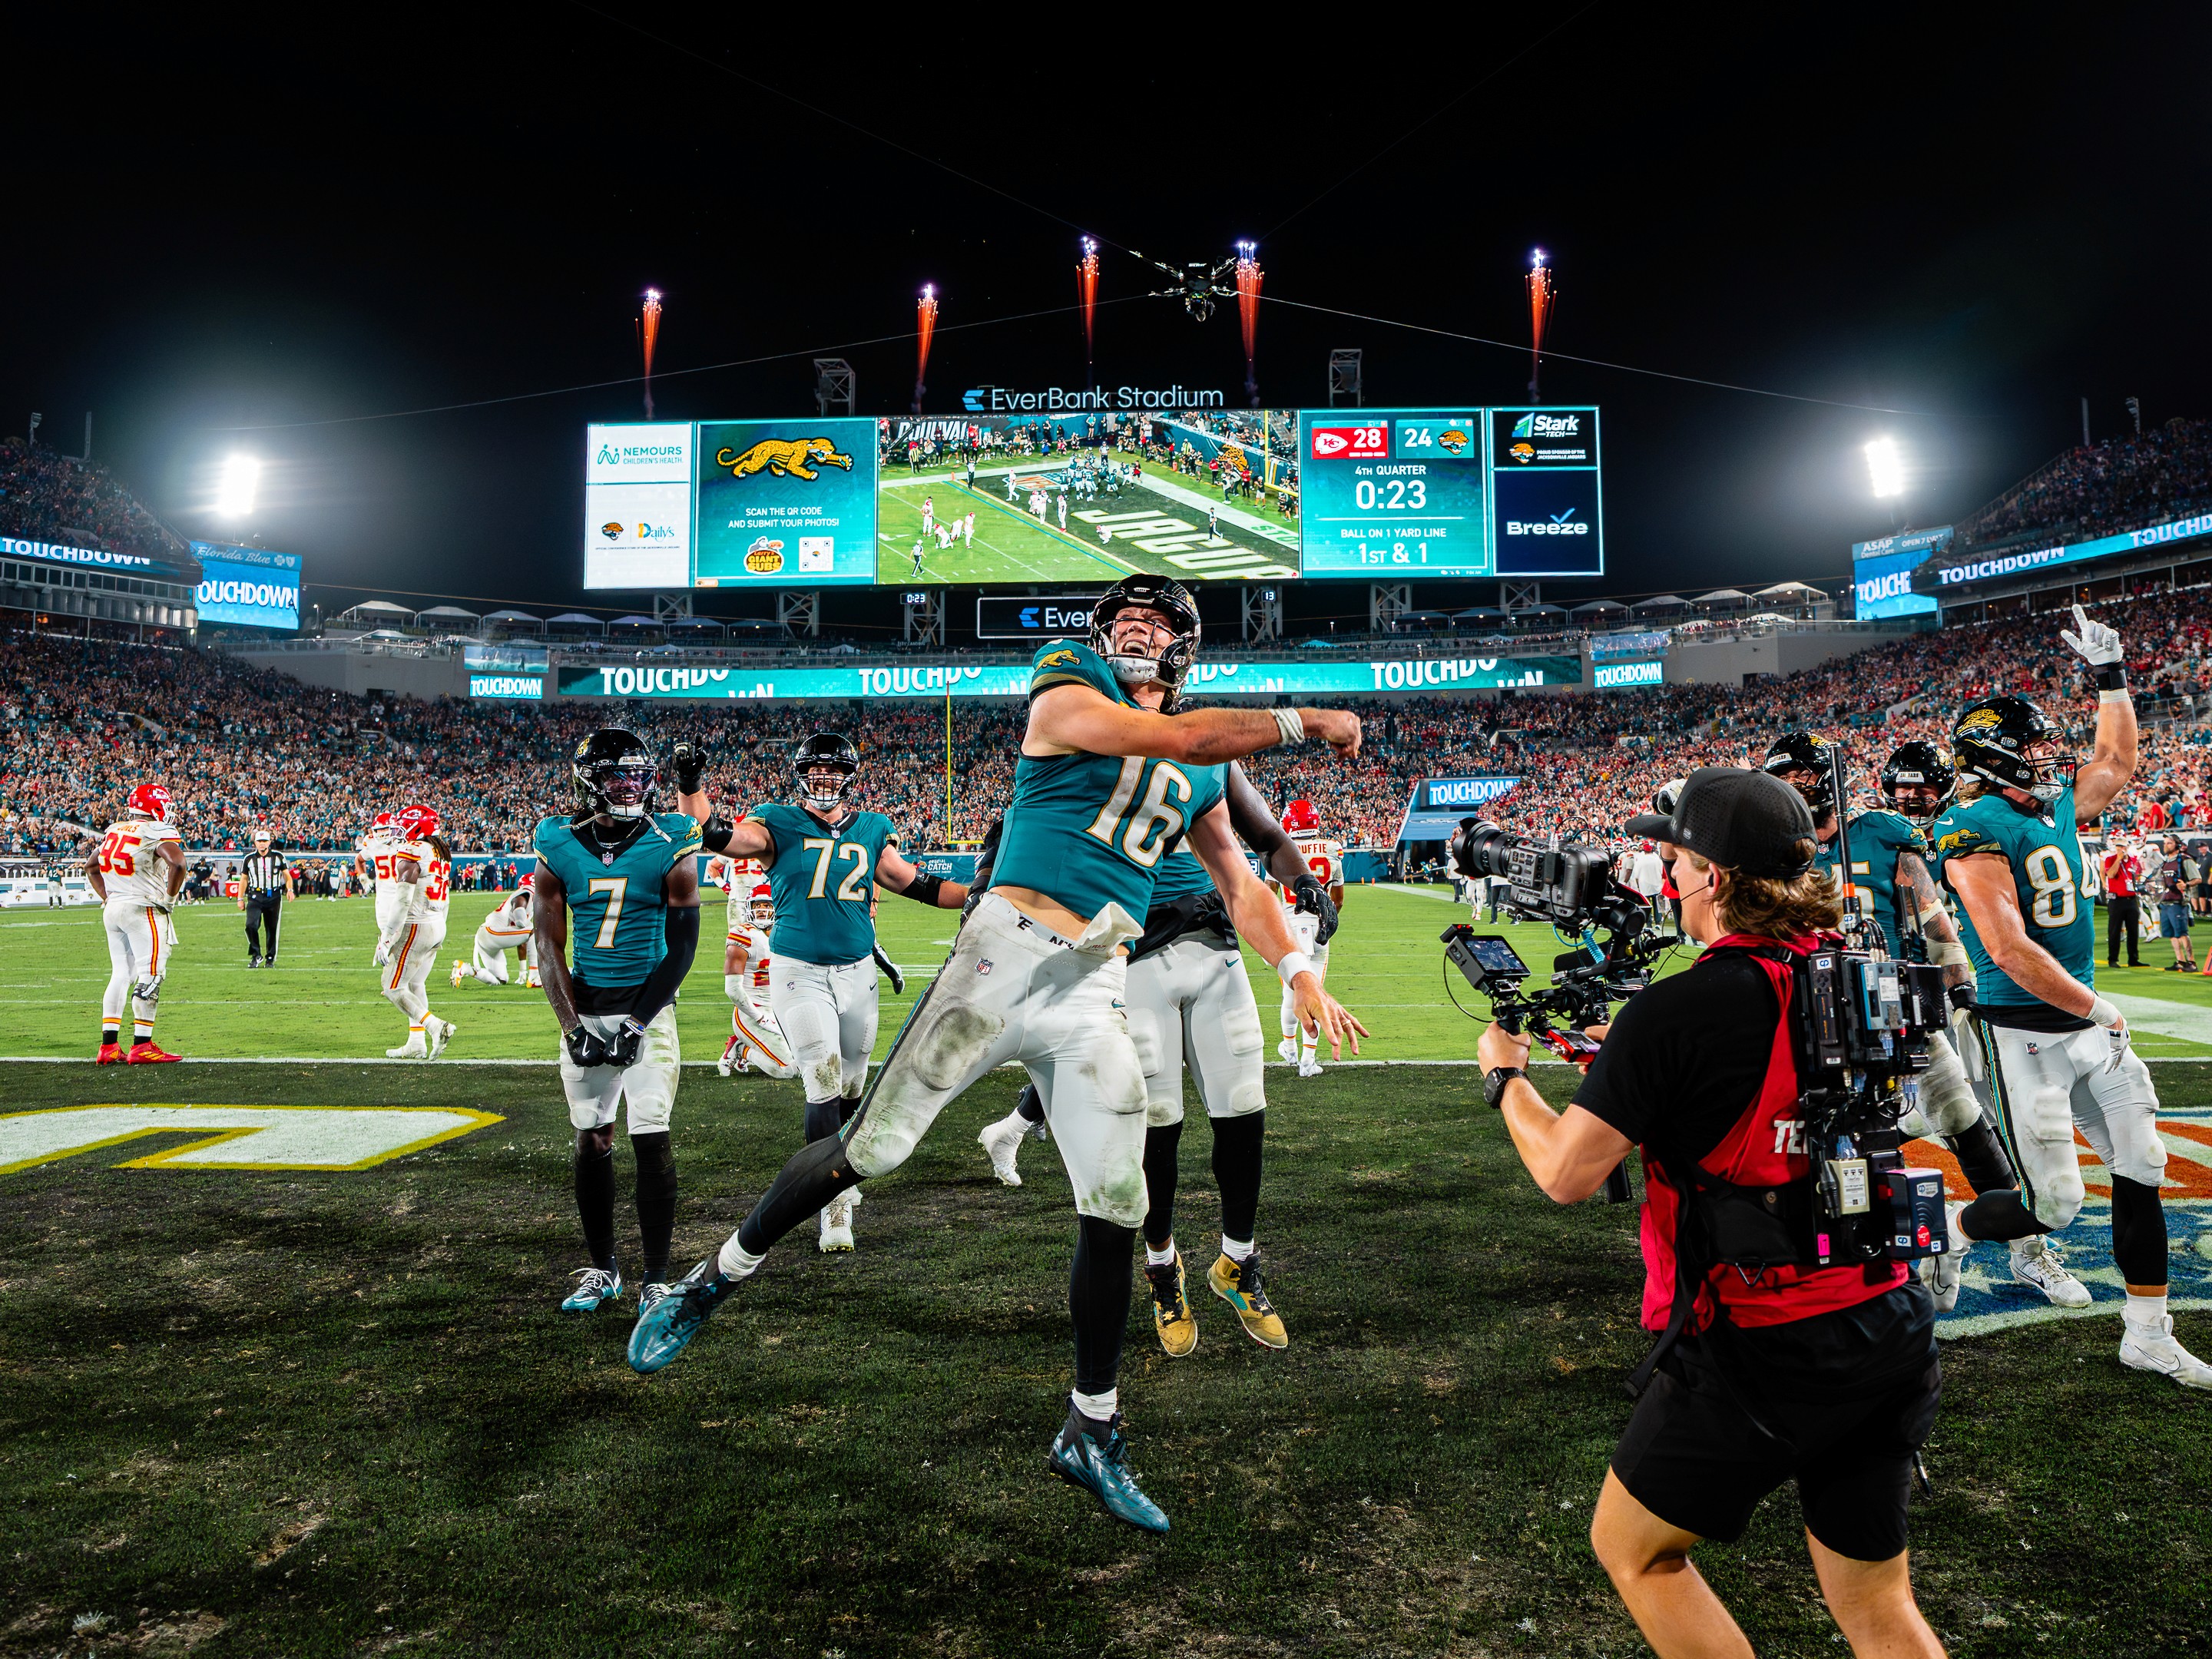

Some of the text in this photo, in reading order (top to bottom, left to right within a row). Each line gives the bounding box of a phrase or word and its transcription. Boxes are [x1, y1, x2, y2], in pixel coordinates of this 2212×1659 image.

[992, 385, 1224, 410] EverBank Stadium
[1534, 415, 1580, 431] Stark
[1353, 428, 1382, 448] 28
[1404, 428, 1432, 448] 24
[624, 446, 682, 456] NEMOURS
[1355, 465, 1427, 475] 4TH QUARTER
[1356, 479, 1427, 509] 0:23
[745, 507, 823, 517] SCAN THE QR CODE
[638, 522, 674, 543] Daily's
[728, 518, 839, 528] AND SUBMIT YOUR PHOTOS!
[1340, 528, 1447, 538] BALL ON 1 YARD LINE
[1507, 521, 1589, 535] Breeze
[197, 545, 271, 565] Florida Blue
[1358, 542, 1427, 564] 1ST & 1
[1863, 538, 1893, 552] ASAP
[747, 555, 780, 563] GIANT
[747, 562, 781, 571] SUBS
[1938, 545, 2065, 584] TOUCHDOWN
[197, 580, 298, 610] OUCHDOWN
[906, 594, 926, 603] 0:23
[1265, 591, 1274, 601] 13
[1595, 662, 1663, 688] TOUCHDOWN
[471, 677, 542, 697] TOUCHDOWN
[1085, 755, 1192, 867] 16
[98, 832, 142, 877] 95
[803, 838, 869, 902] 72
[928, 863, 953, 871] CATCH
[2025, 830, 2095, 928] 84
[588, 877, 628, 949] 7
